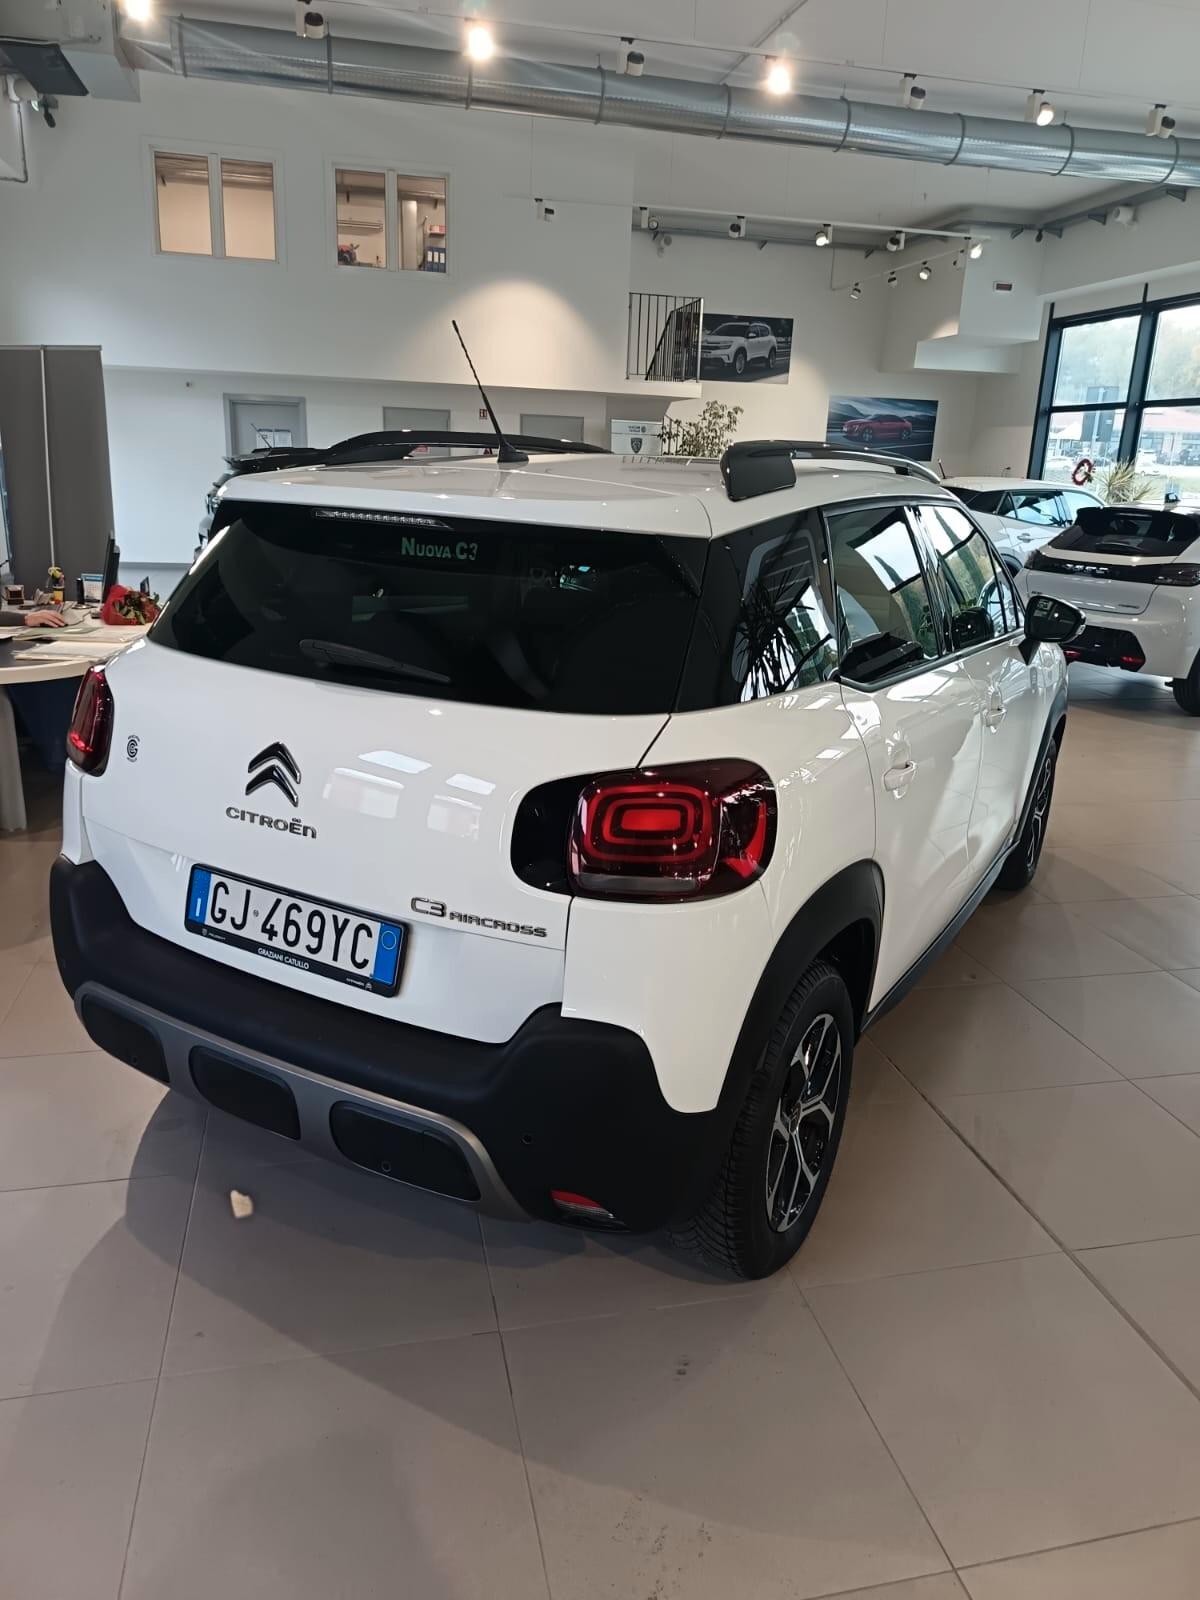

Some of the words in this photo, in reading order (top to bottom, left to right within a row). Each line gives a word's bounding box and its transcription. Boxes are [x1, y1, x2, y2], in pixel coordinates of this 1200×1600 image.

[455, 541, 478, 561] C3
[410, 897, 447, 918] C3
[449, 911, 548, 938] AIRCROSS
[257, 947, 284, 962] GRAZIANI
[284, 956, 310, 970] CATULLO
